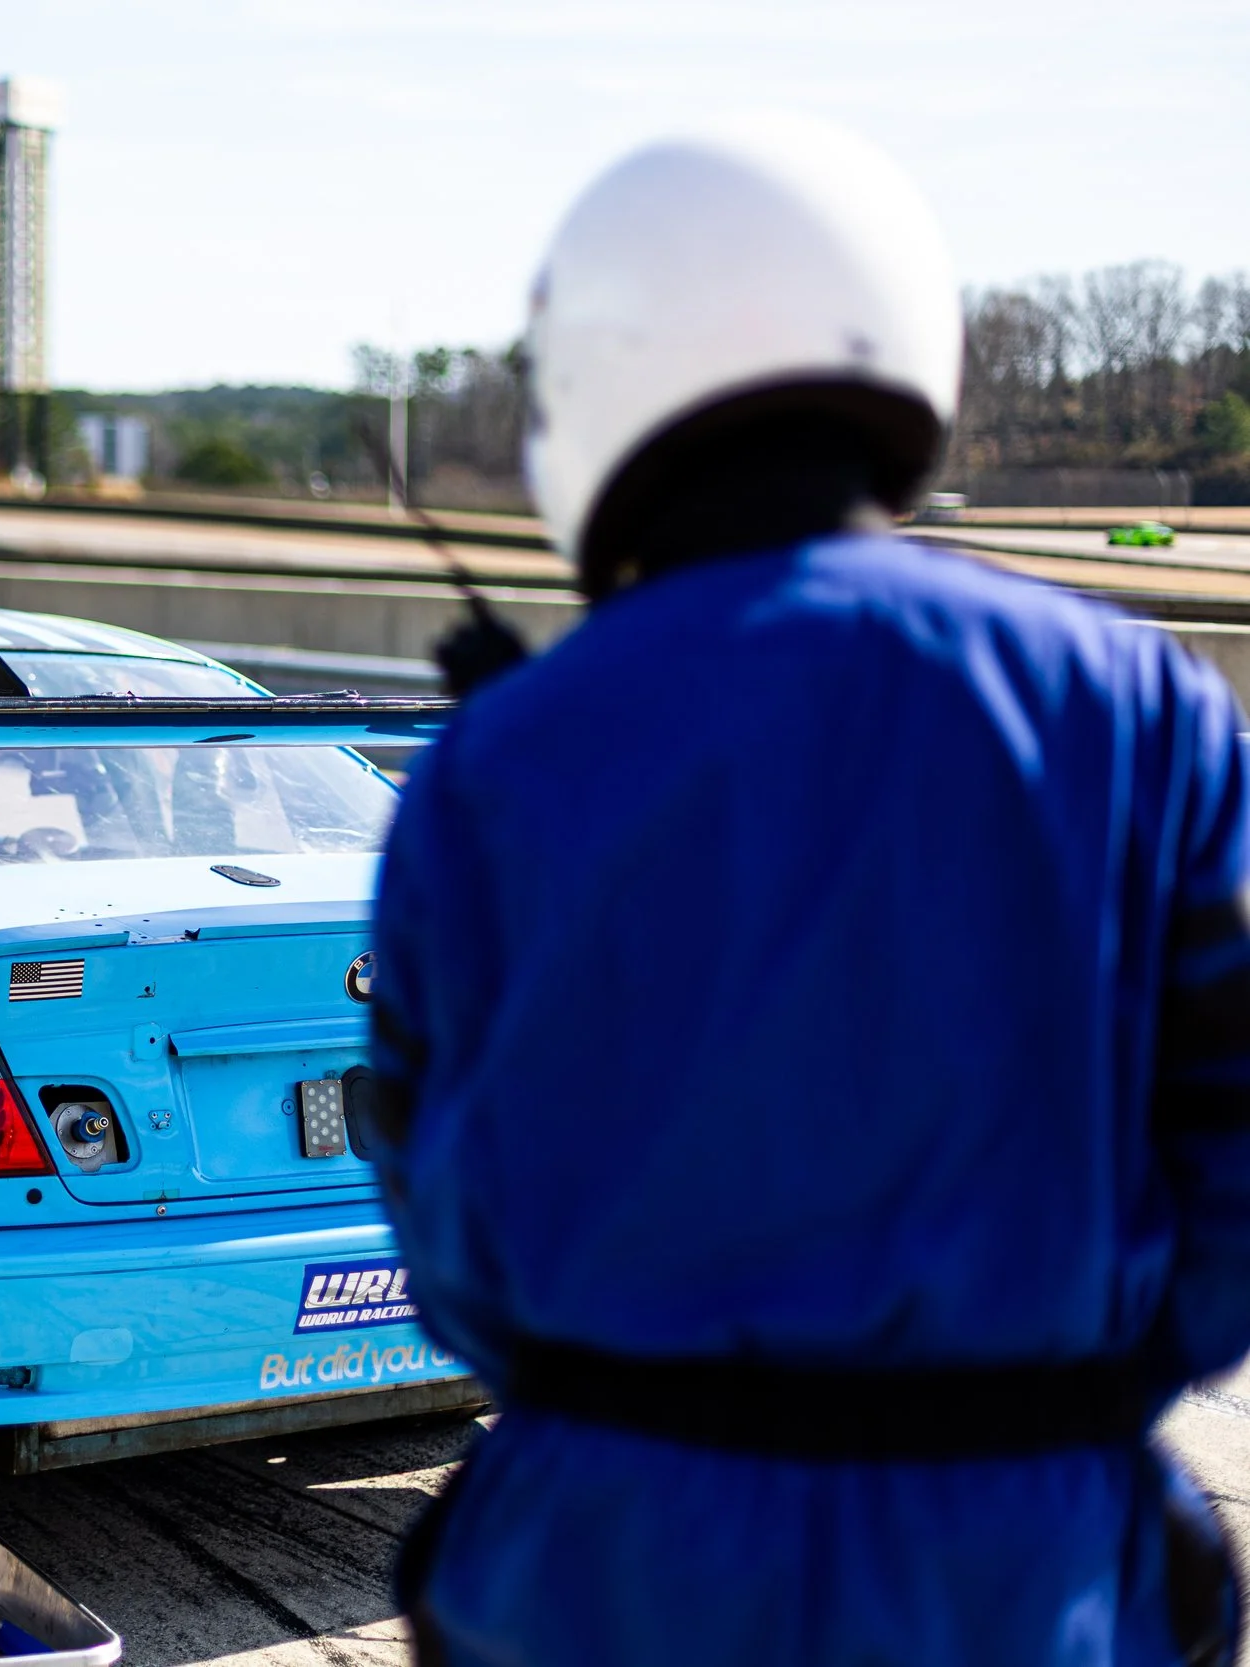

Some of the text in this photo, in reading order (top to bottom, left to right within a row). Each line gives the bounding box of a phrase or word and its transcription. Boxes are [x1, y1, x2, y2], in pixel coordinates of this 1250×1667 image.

[305, 1268, 409, 1308] WRL
[299, 1310, 358, 1327] WORLD
[260, 1353, 314, 1389] But
[317, 1341, 369, 1382] did
[371, 1344, 427, 1383] you
